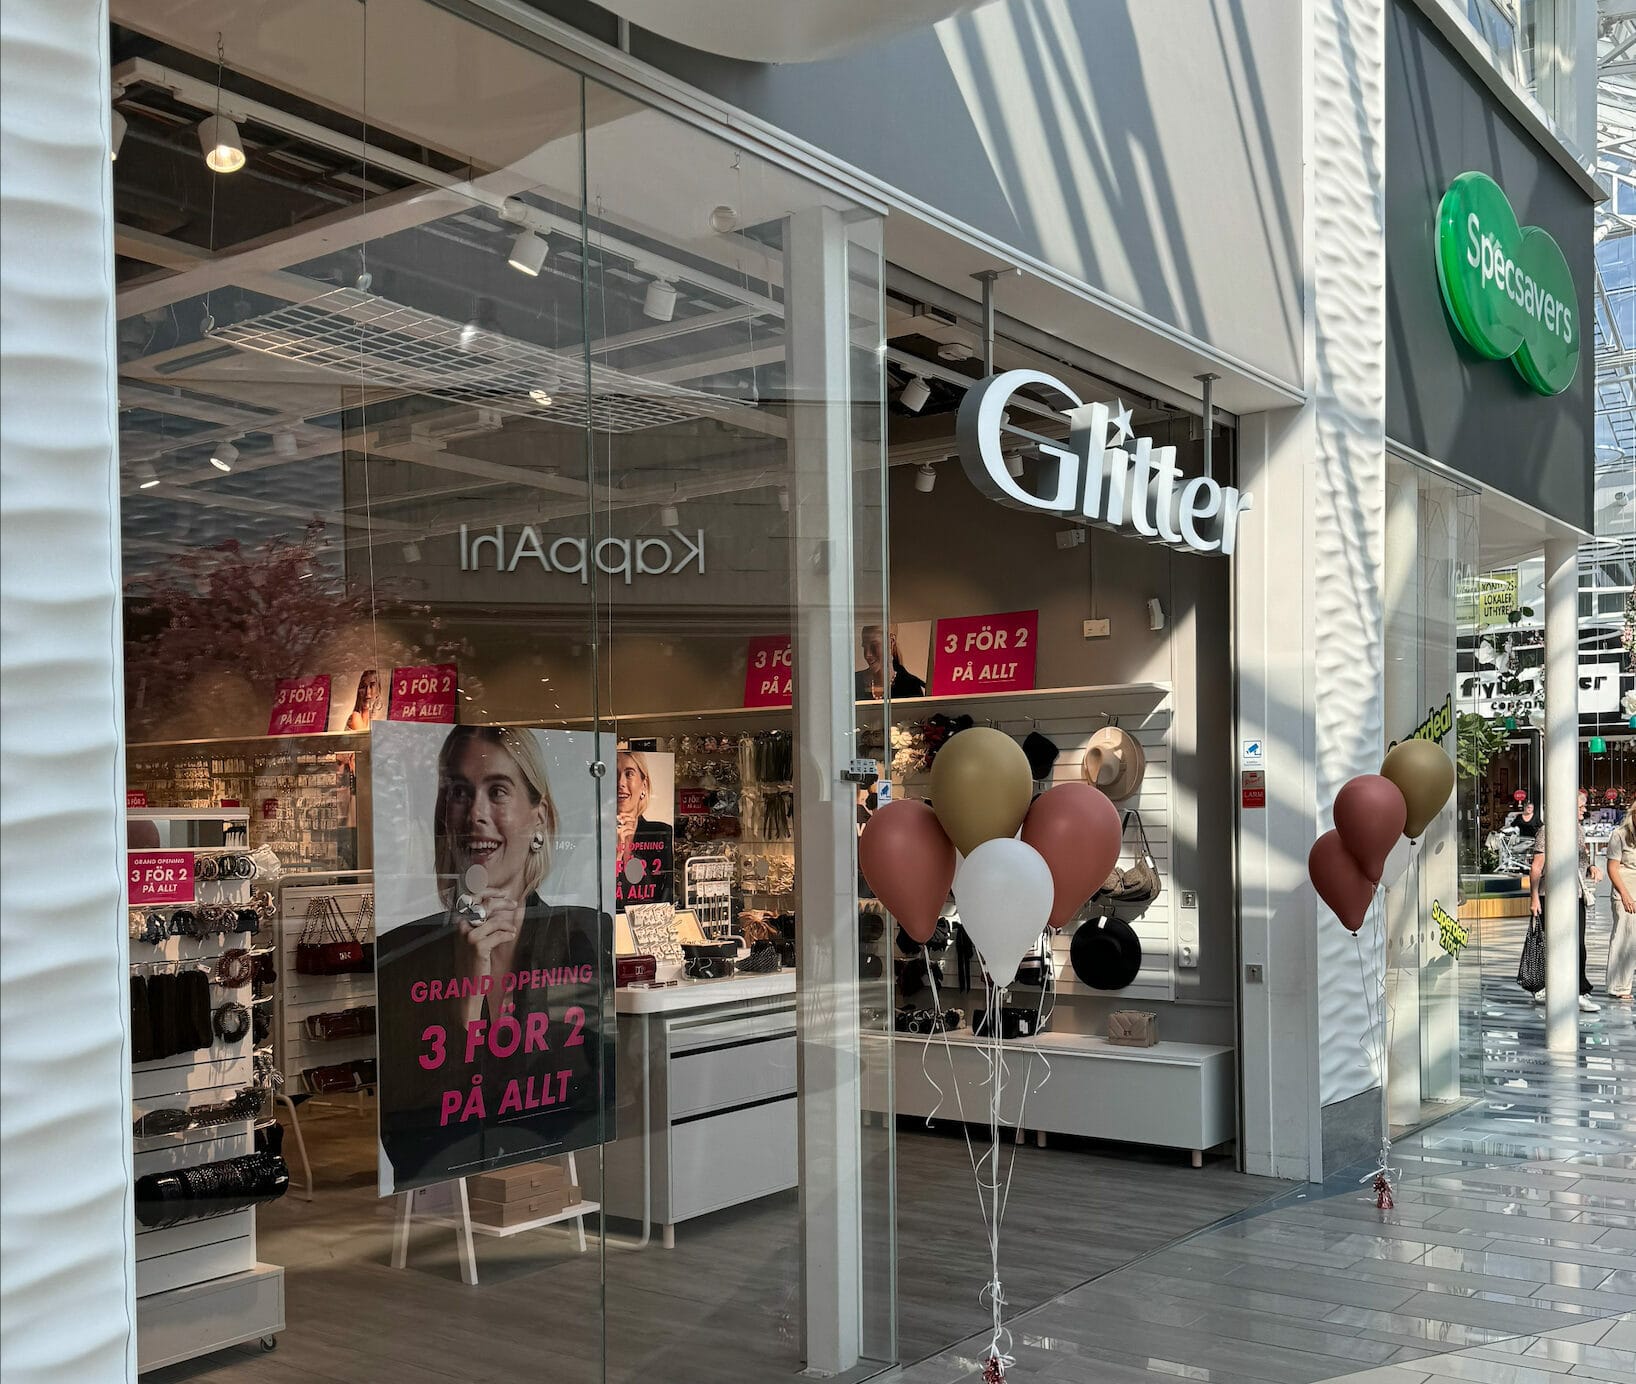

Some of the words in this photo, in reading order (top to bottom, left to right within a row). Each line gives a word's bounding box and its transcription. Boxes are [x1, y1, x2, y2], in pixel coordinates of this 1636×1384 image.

[1467, 213, 1571, 344] Specsavers
[957, 368, 1254, 556] Glitter
[944, 634, 959, 654] 3
[965, 626, 1007, 651] FÖR
[1015, 628, 1029, 648] 2
[755, 651, 766, 669] 3
[952, 660, 974, 682] PÅ
[978, 662, 1018, 680] ALLT
[278, 691, 286, 705] 3
[289, 685, 313, 703] FÖR
[315, 687, 325, 701] 2
[398, 680, 408, 695] 3
[411, 675, 438, 694] FÖR
[442, 676, 451, 693] 2
[761, 675, 779, 695] PÅ
[279, 710, 293, 725] PÅ
[293, 712, 317, 725] ALLT
[402, 702, 417, 718] PÅ
[419, 704, 445, 717] ALLT
[629, 841, 664, 852] OPENING
[131, 870, 140, 882] 3
[145, 866, 174, 882] FÖR
[178, 868, 187, 881] 2
[652, 858, 663, 875] 2
[142, 882, 155, 893] PÅ
[157, 883, 178, 893] ALLT
[616, 881, 623, 900] Å
[627, 884, 656, 899] ALLT
[1432, 899, 1469, 948] Superdeal
[410, 975, 494, 1003] GRAND
[502, 963, 593, 993] OPENING
[418, 1025, 447, 1070] 3
[465, 1003, 550, 1063] FÖR
[563, 1006, 586, 1048] 2
[440, 1074, 487, 1126] PÅ
[498, 1070, 573, 1115] ALLT
